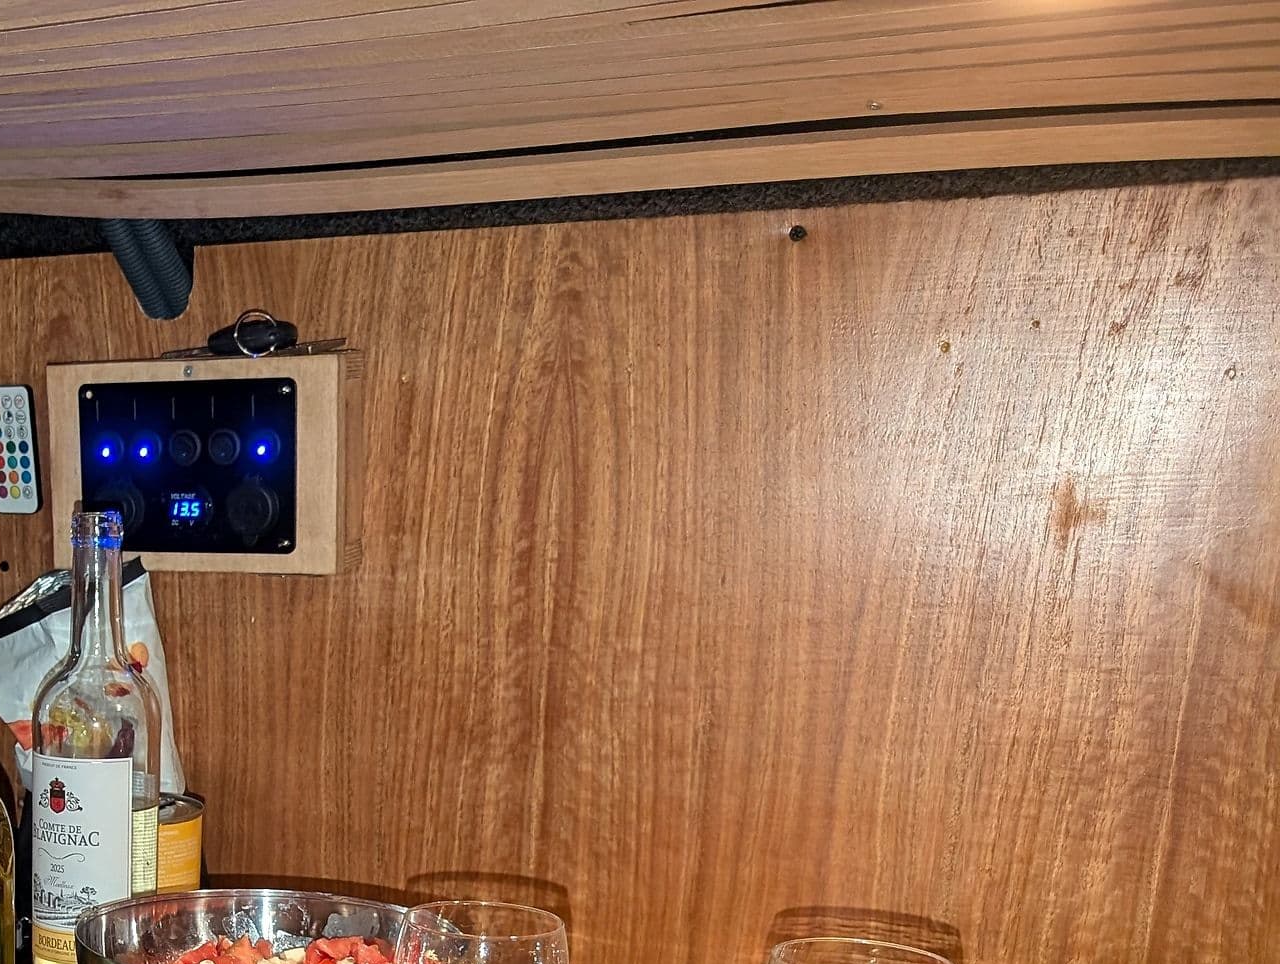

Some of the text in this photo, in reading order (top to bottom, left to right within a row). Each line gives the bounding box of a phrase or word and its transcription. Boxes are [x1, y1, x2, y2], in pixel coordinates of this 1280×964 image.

[173, 502, 200, 517] 13.5
[38, 818, 82, 834] COMTE DE
[38, 933, 76, 952] BORDEAU
